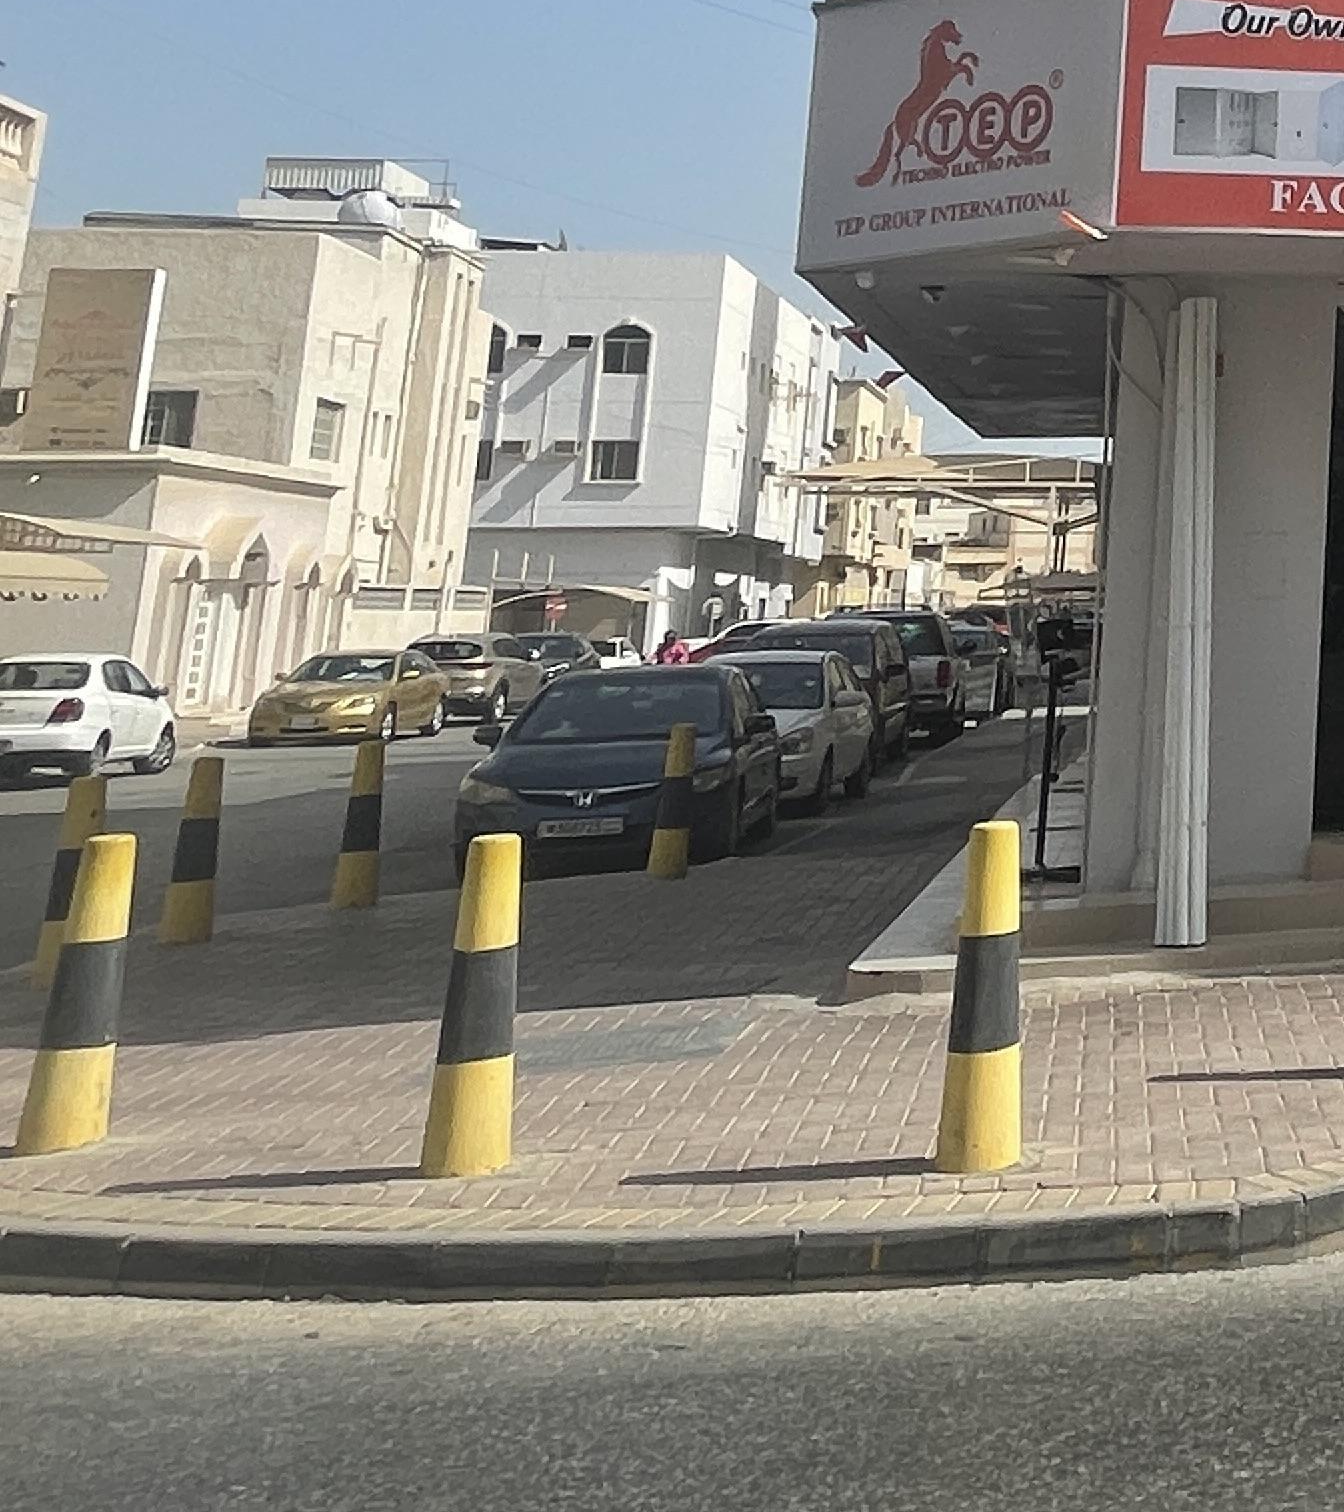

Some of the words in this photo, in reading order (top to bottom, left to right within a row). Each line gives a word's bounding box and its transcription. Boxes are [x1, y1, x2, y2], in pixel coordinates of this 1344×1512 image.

[1221, 3, 1280, 35] Our
[929, 92, 1048, 158] TEP
[834, 216, 865, 238] TEP
[868, 208, 926, 232] GROUP
[931, 188, 1071, 224] INTERNATIONAL
